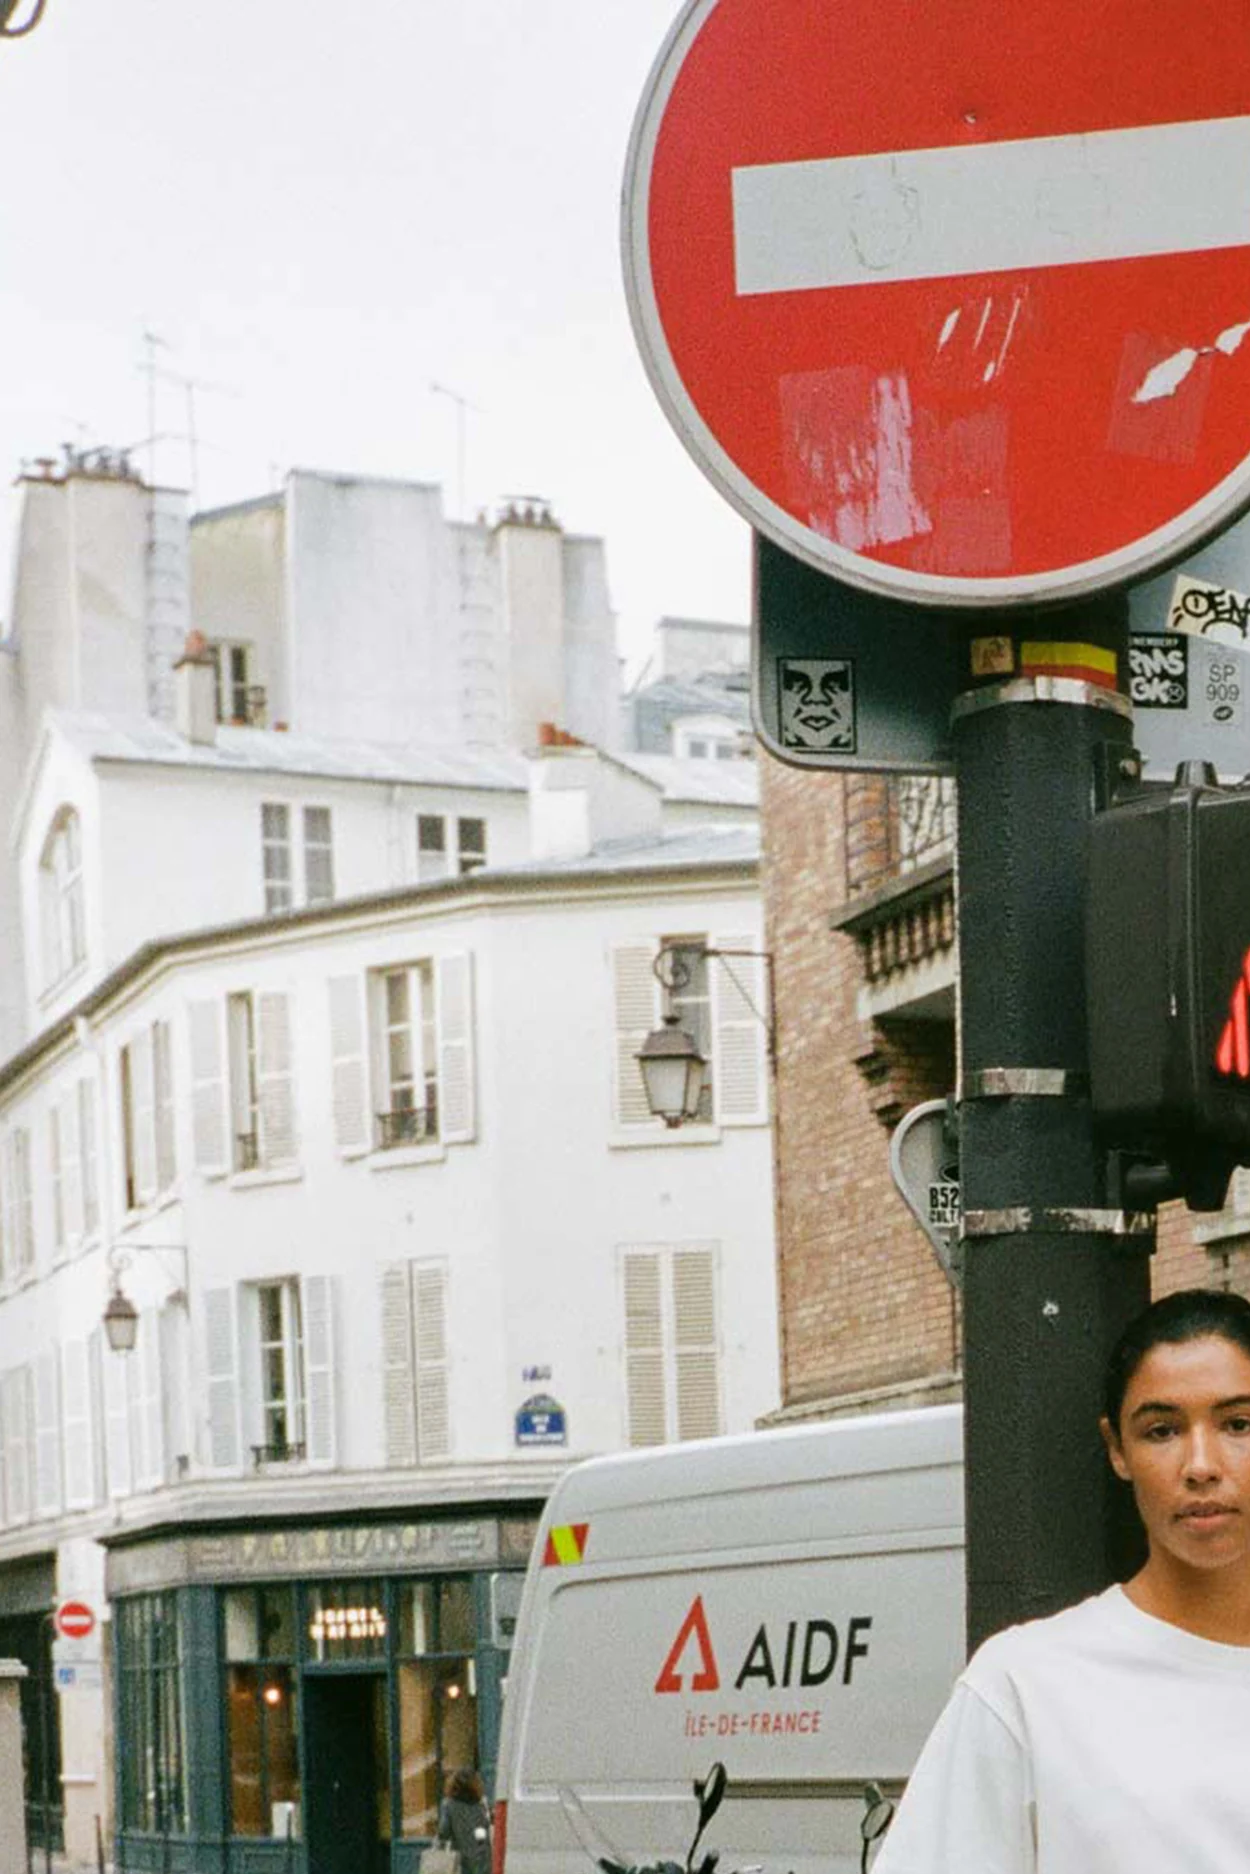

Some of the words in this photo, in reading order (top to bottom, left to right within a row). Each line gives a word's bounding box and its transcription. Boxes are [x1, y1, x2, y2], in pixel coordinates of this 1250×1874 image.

[1209, 664, 1236, 683] SP
[1206, 683, 1240, 702] 909
[930, 1186, 960, 1209] B52
[734, 1616, 873, 1690] AIDF
[684, 1710, 822, 1738] ÎLE-DE-FRANCE
